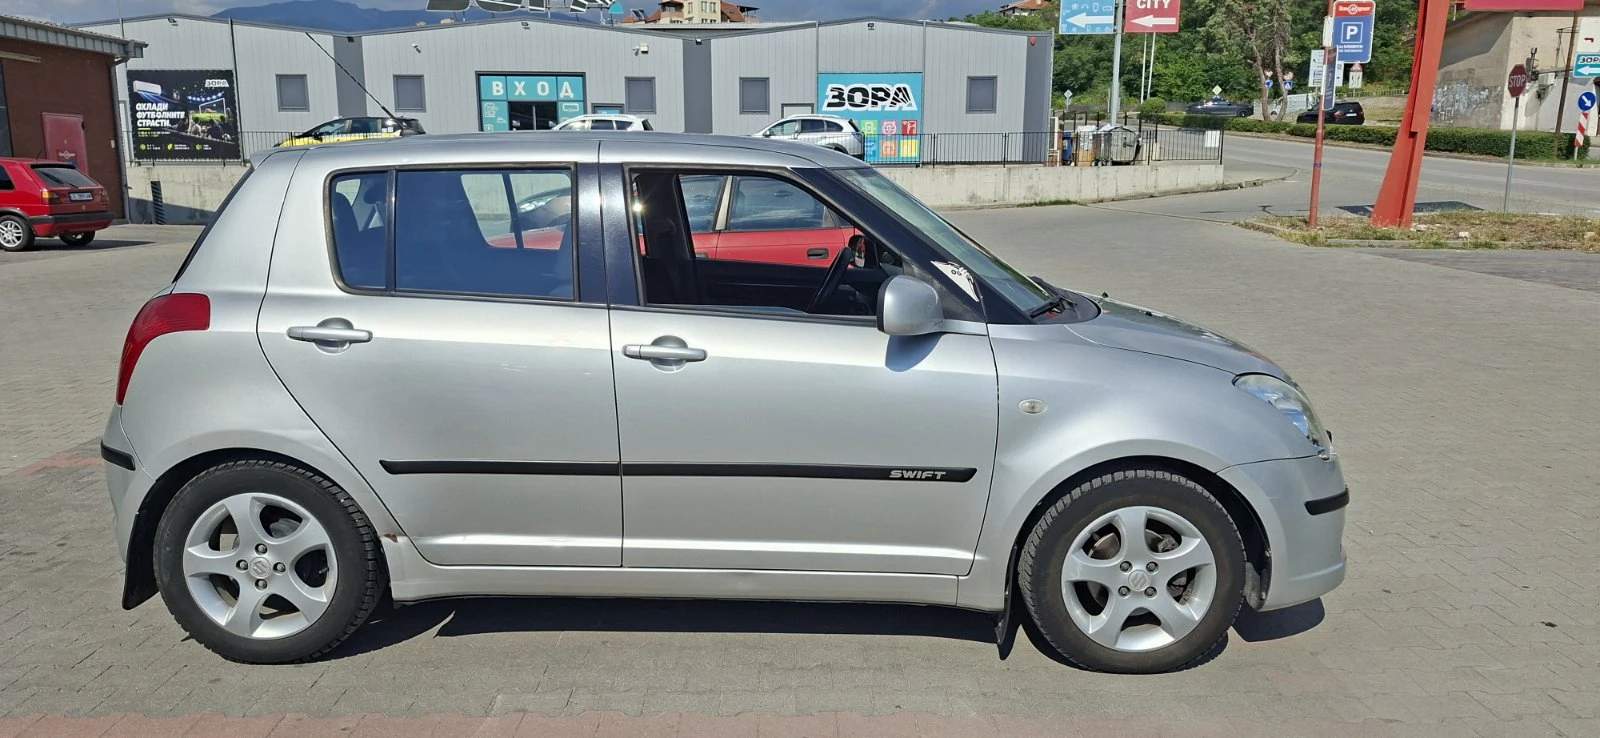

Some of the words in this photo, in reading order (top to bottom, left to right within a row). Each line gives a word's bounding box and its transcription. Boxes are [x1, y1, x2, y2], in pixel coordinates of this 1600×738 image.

[1136, 0, 1170, 9] CITY
[1509, 75, 1526, 88] STOP
[492, 80, 574, 98] ВХОД
[825, 86, 914, 108] ЗОРА
[136, 103, 169, 111] ОХЛАДИ
[136, 111, 185, 119] ФУТБОЛНИТЕ
[137, 119, 171, 127] СТРАСТИ.
[889, 469, 946, 479] SWIFT
